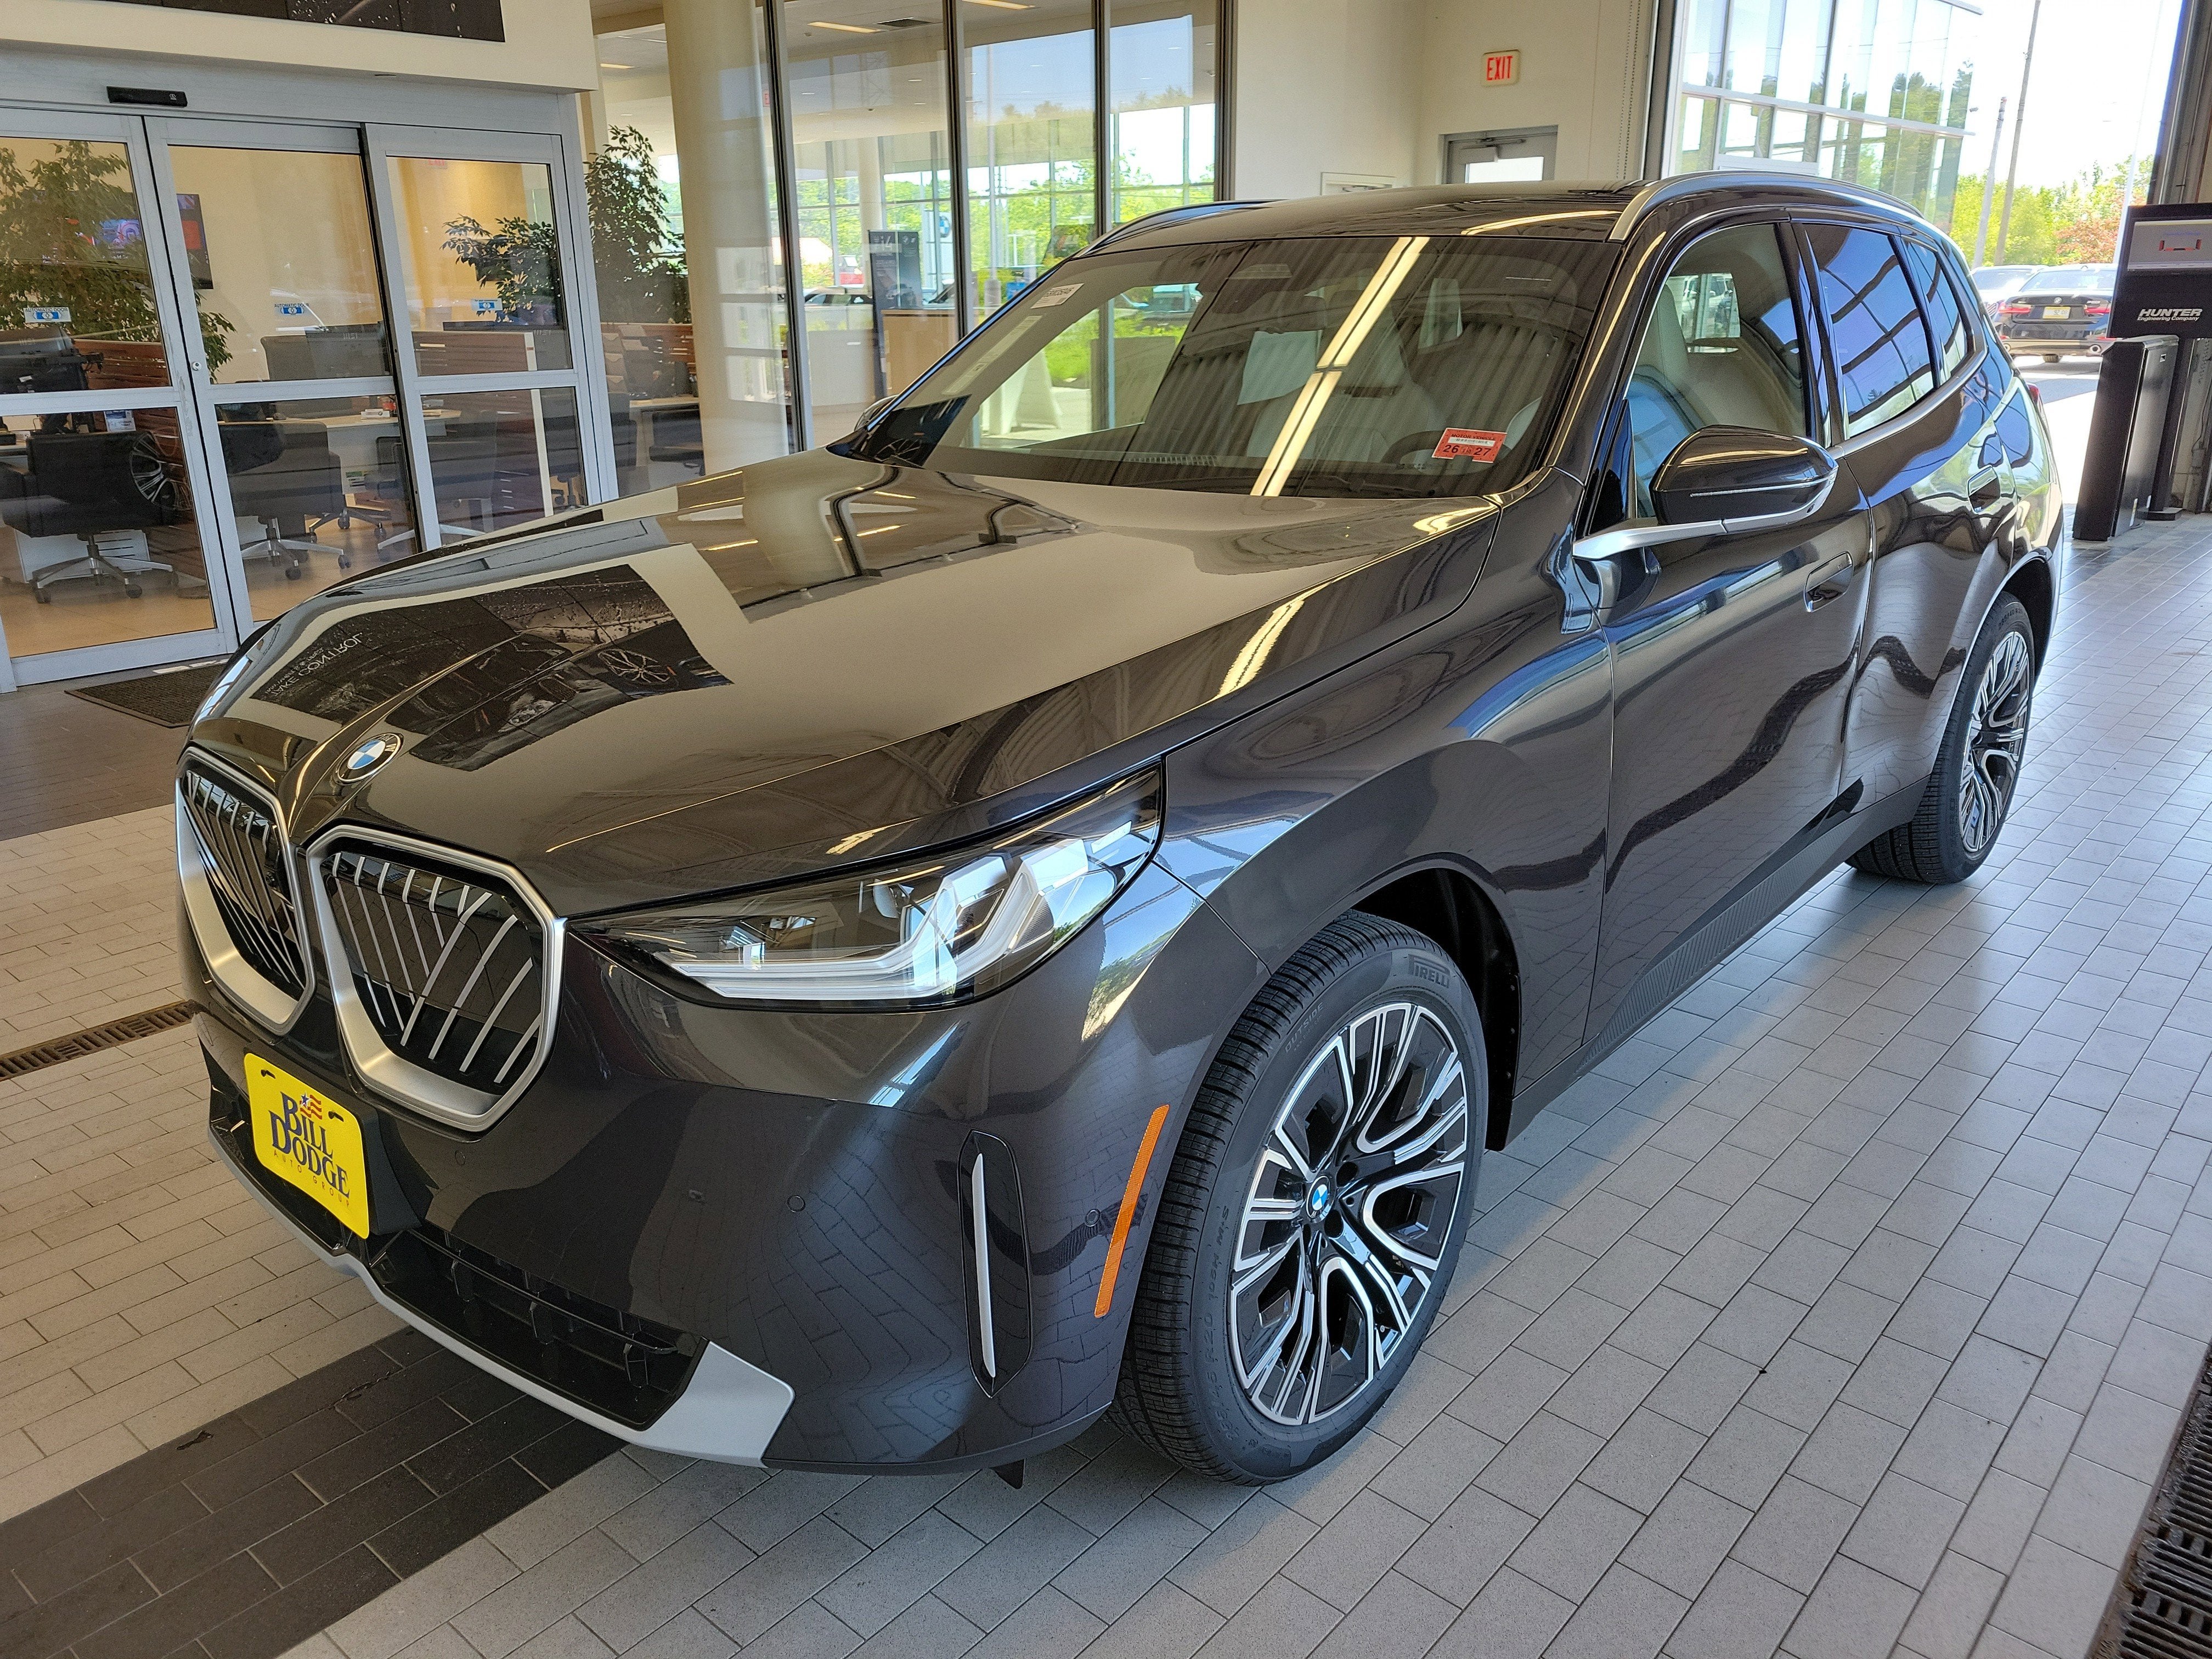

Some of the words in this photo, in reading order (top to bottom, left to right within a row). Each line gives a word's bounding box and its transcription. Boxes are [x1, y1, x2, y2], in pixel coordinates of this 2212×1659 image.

[1486, 55, 1513, 81] EXIT
[2139, 308, 2203, 317] HUNTER
[1443, 444, 1459, 453] 26
[1473, 447, 1491, 456] 27
[1408, 954, 1451, 989] PIRELLI
[1285, 1002, 1324, 1053] OUTSIDE
[280, 1091, 333, 1159] BILL
[268, 1110, 350, 1199] DODGE
[274, 1149, 302, 1173] AUTO
[313, 1175, 349, 1207] GROUP
